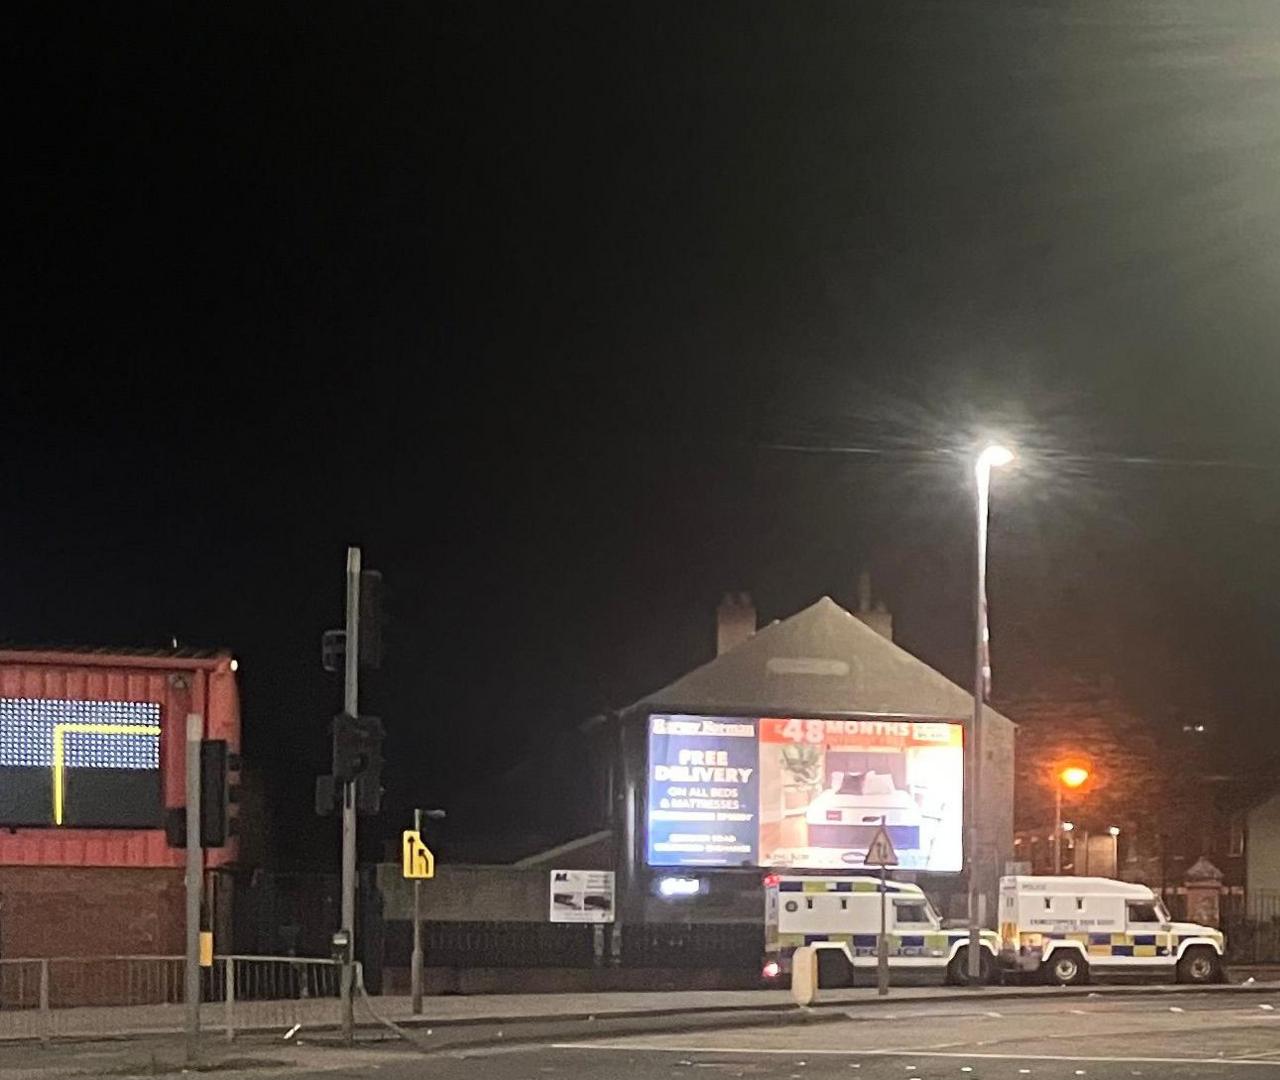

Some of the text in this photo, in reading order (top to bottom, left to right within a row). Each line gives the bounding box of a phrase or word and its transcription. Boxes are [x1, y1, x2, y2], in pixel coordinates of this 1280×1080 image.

[783, 719, 825, 743] 48
[826, 721, 910, 736] MONTHS
[679, 749, 729, 767] FREE
[655, 765, 753, 783] DELIVERY
[688, 787, 709, 798] ALL
